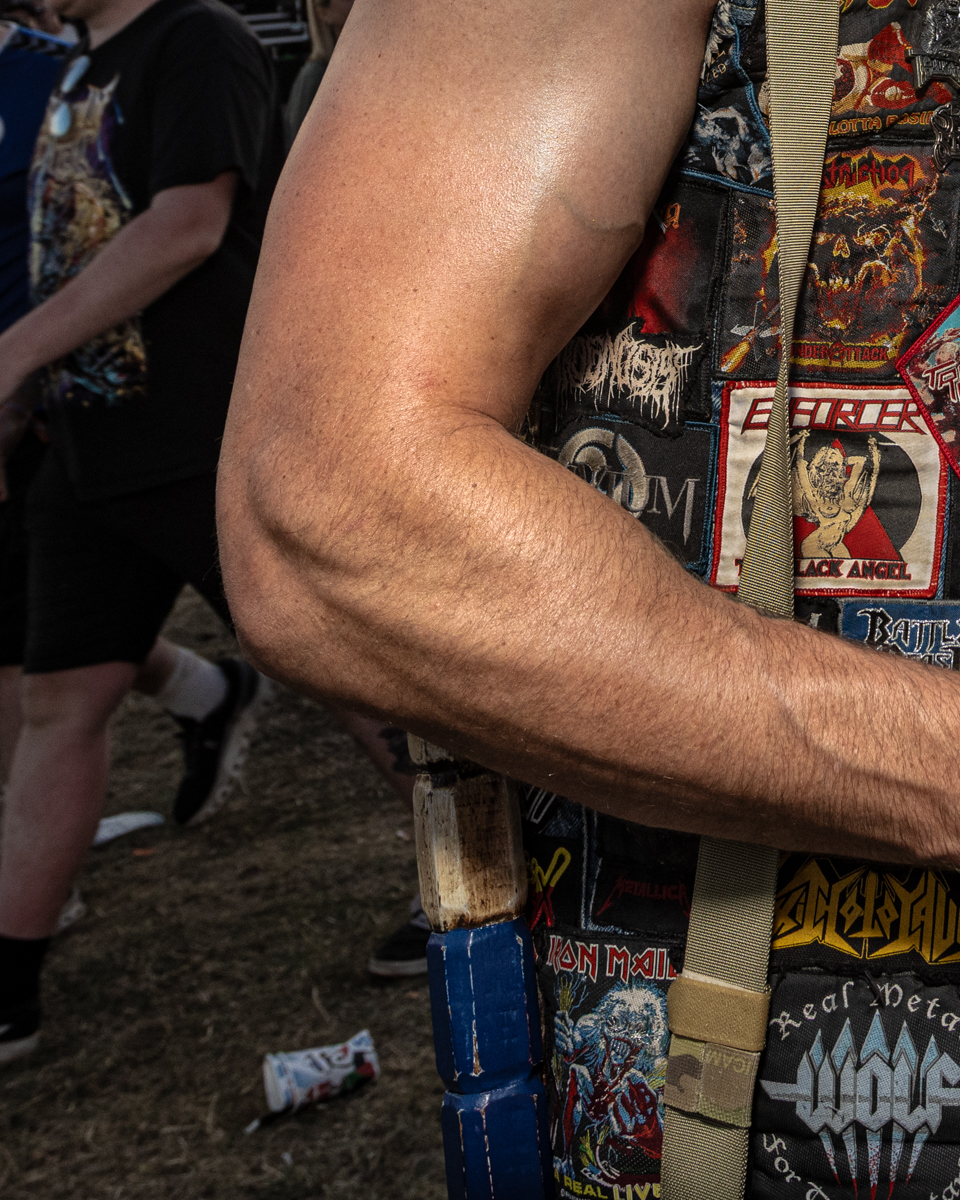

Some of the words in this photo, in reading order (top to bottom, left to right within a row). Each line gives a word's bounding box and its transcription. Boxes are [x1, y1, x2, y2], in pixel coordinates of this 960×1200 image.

[829, 116, 882, 135] LOTTA
[741, 397, 927, 435] EFORCER
[796, 560, 843, 578] LACK
[847, 560, 912, 580] ANGEL
[596, 873, 691, 918] METALLICA
[546, 935, 599, 983] IRON
[605, 944, 678, 985] MAI
[769, 981, 854, 1041] Real
[704, 1049, 757, 1076] ICAM
[564, 1175, 608, 1199] REAL
